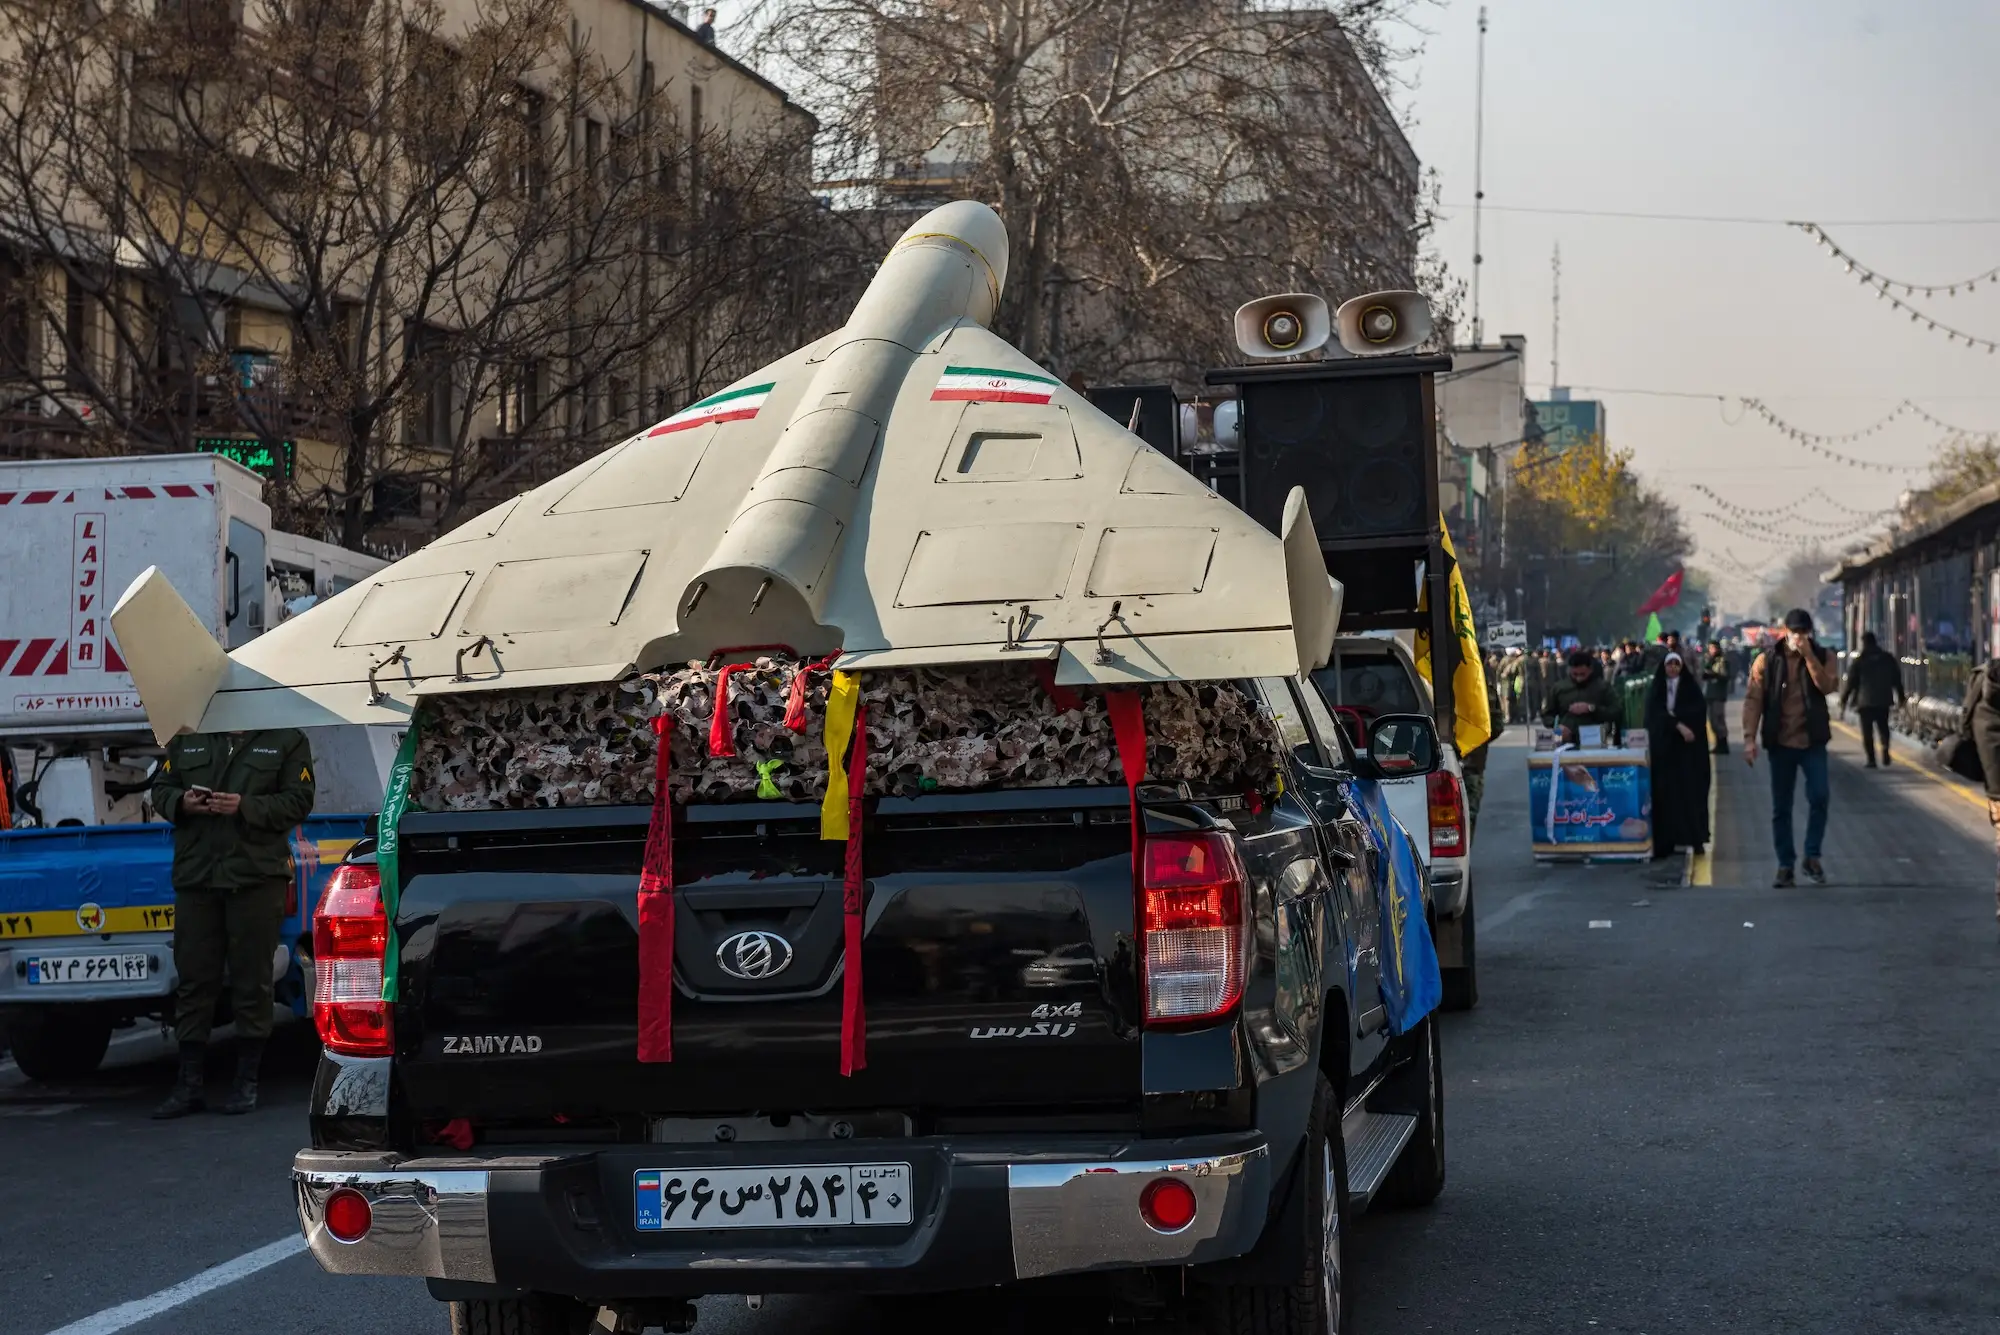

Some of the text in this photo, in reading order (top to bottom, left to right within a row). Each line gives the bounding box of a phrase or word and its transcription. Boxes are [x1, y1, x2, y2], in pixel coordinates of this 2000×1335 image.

[78, 521, 98, 661] LAJVAR
[1489, 627, 1504, 642] نان
[1570, 808, 1616, 828] خیرات
[124, 959, 145, 978] ۴۴
[1030, 1002, 1083, 1019] 4x4
[443, 1035, 543, 1054] ZAMYAD
[859, 1167, 901, 1179] ایران
[639, 1209, 653, 1217] I.R.
[639, 1217, 660, 1226] IRAN
